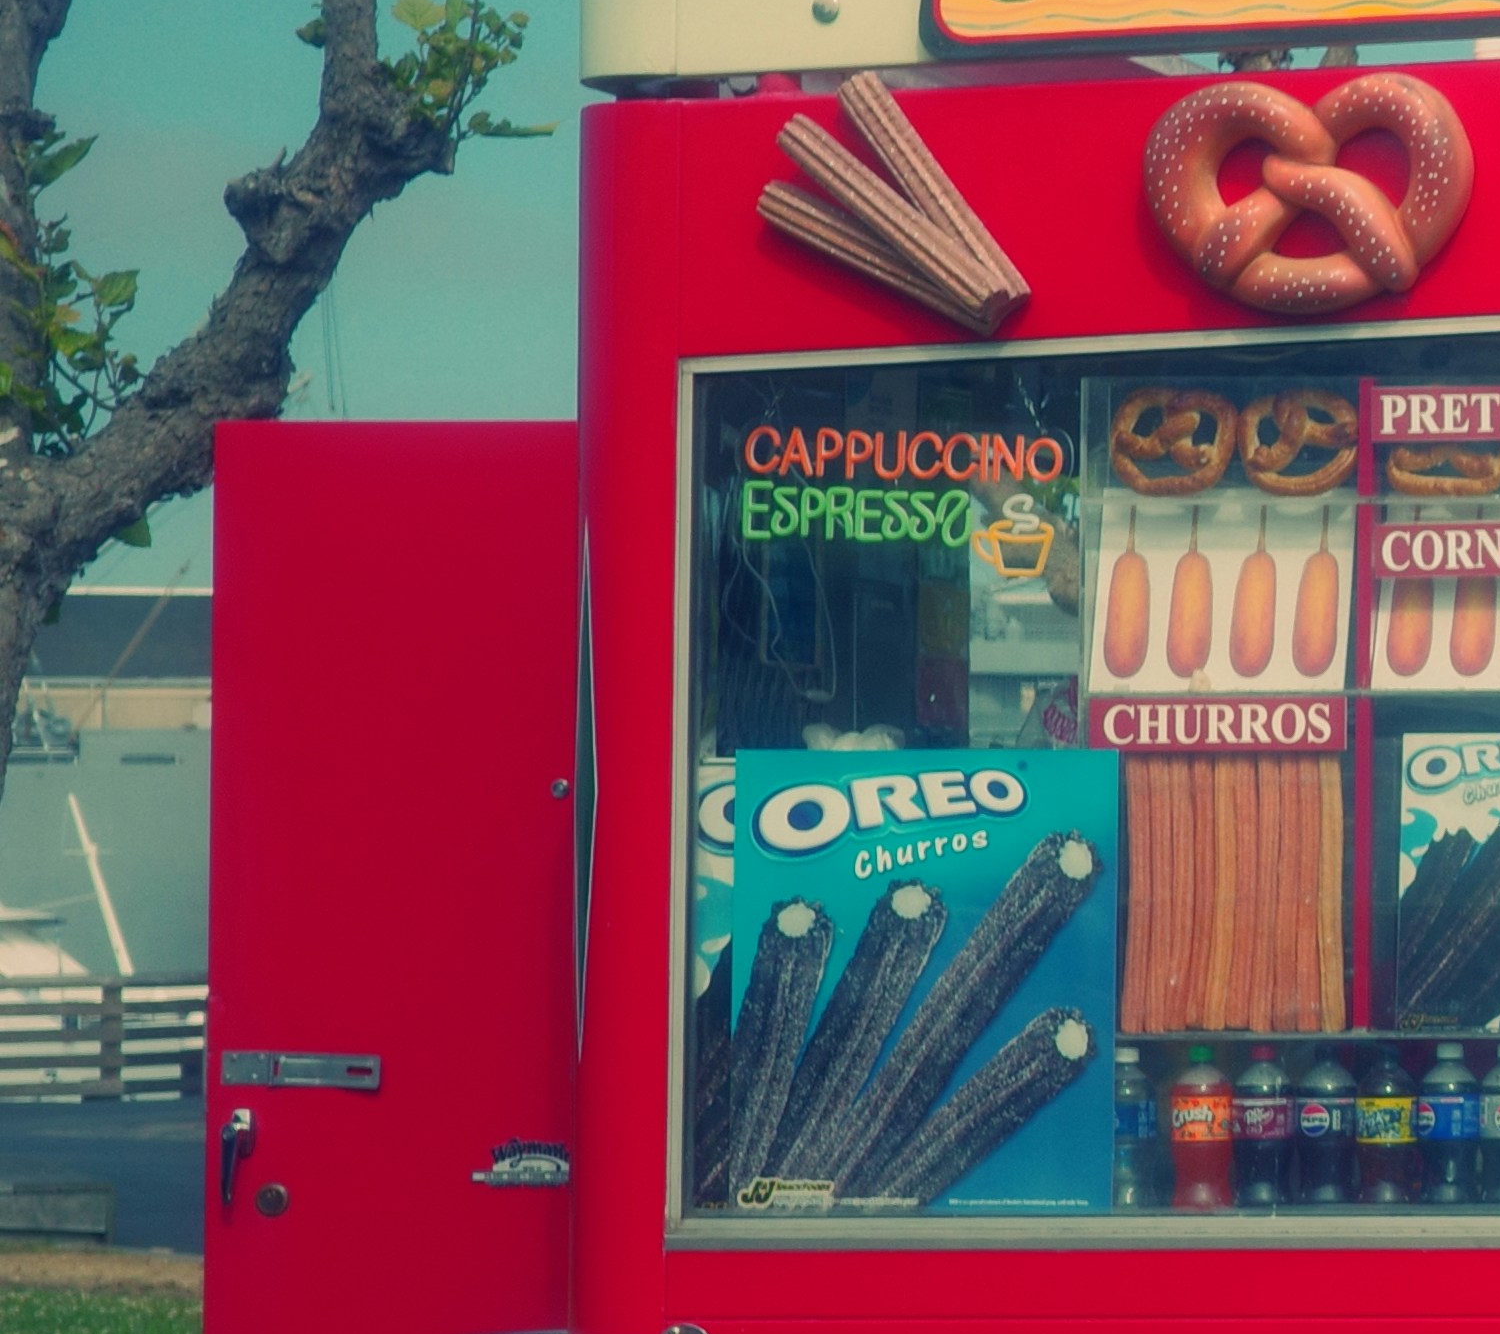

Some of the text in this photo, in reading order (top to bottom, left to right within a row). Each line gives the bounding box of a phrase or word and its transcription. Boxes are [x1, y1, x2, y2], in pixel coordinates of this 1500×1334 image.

[743, 425, 1065, 482] CAPPUCCINO
[741, 479, 973, 548] ESPRESSO
[1103, 701, 1333, 746] CHURROS
[757, 768, 1026, 852] OREO
[853, 829, 989, 880] Churros
[1172, 1103, 1213, 1128] Crush
[1301, 1115, 1329, 1124] PEPSI
